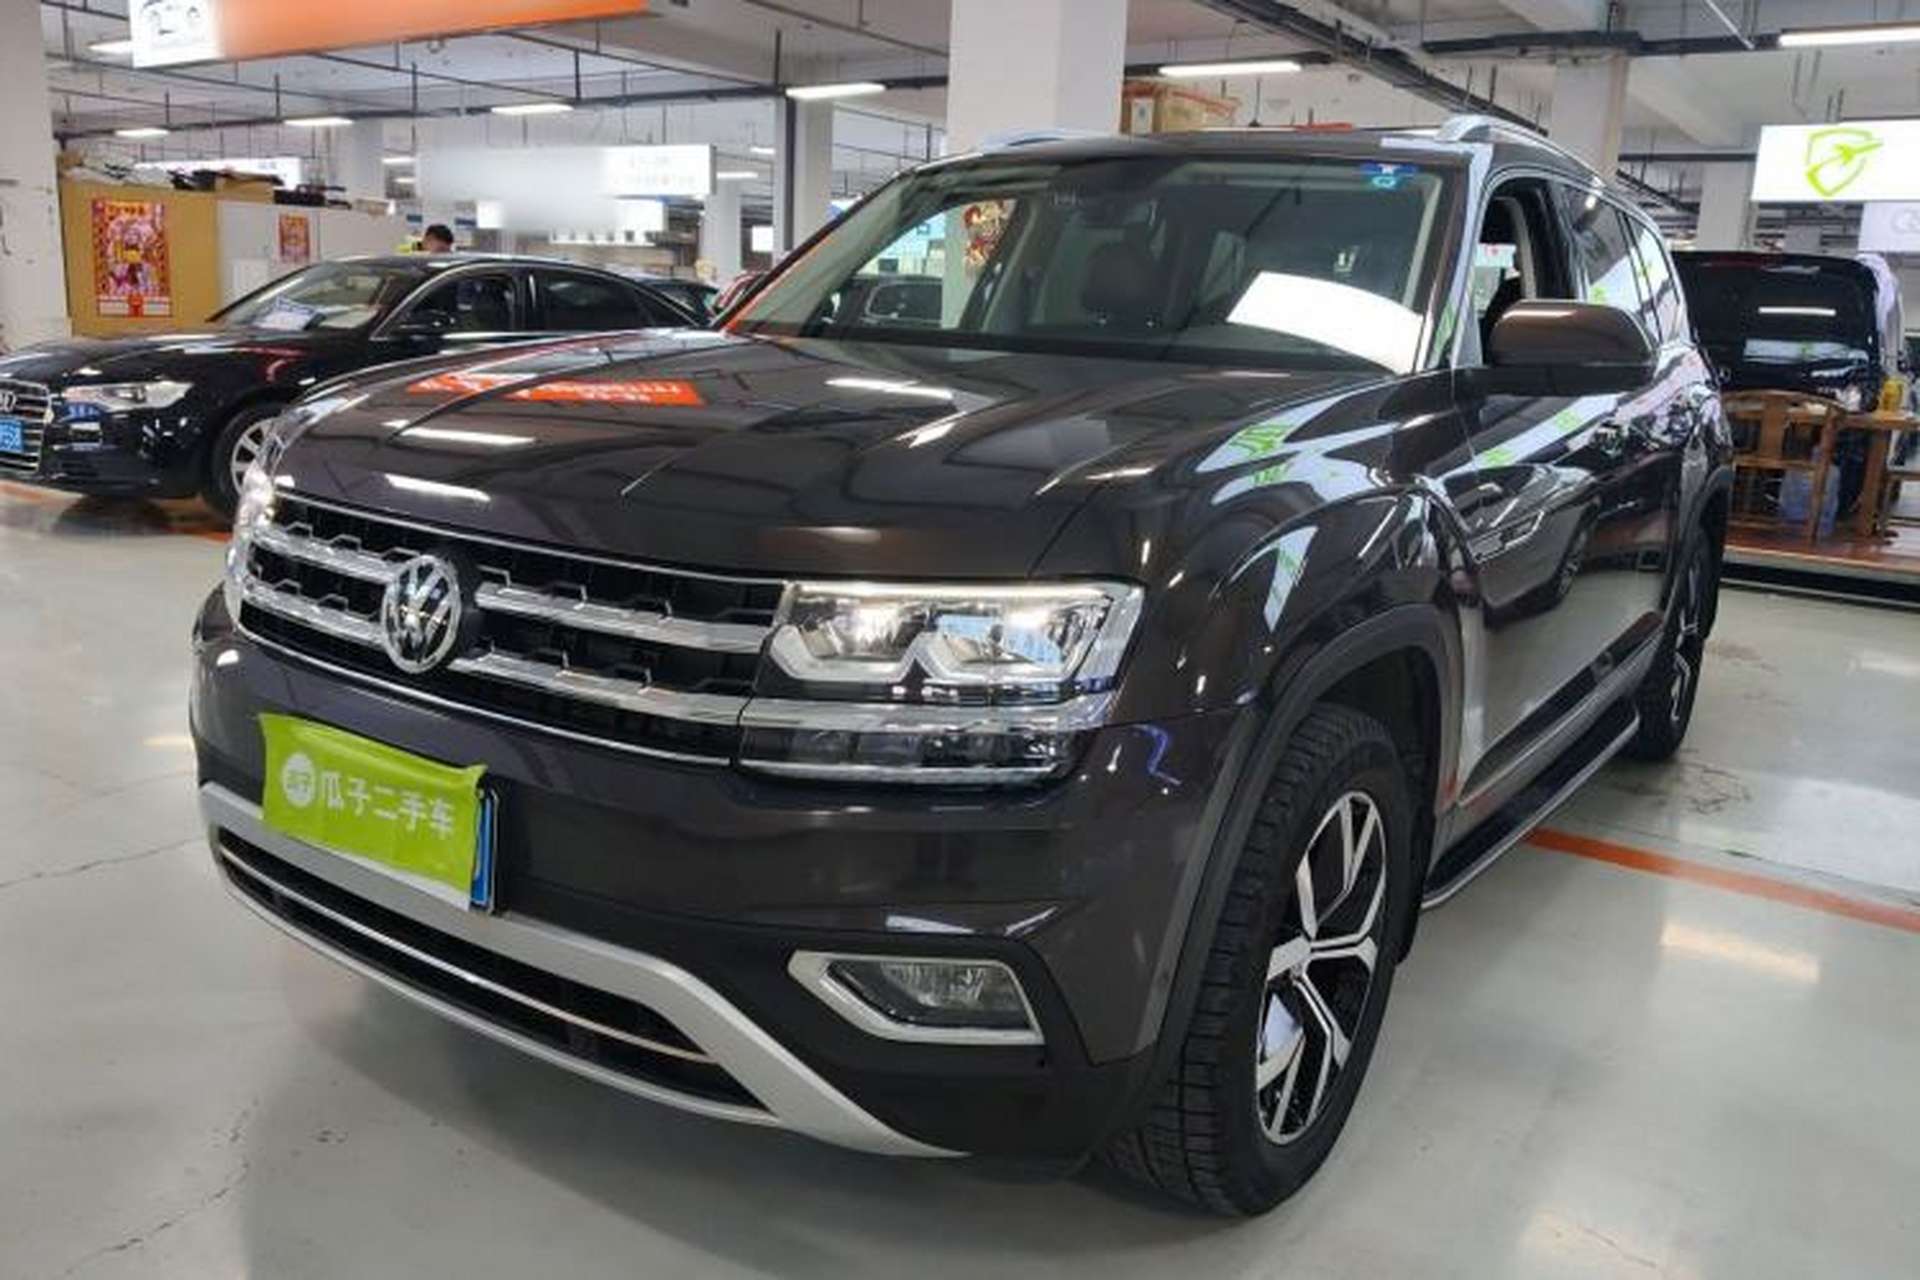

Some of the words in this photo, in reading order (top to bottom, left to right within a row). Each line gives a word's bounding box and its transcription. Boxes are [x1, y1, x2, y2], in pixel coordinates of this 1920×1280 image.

[320, 770, 456, 839] 瓜子二手车
